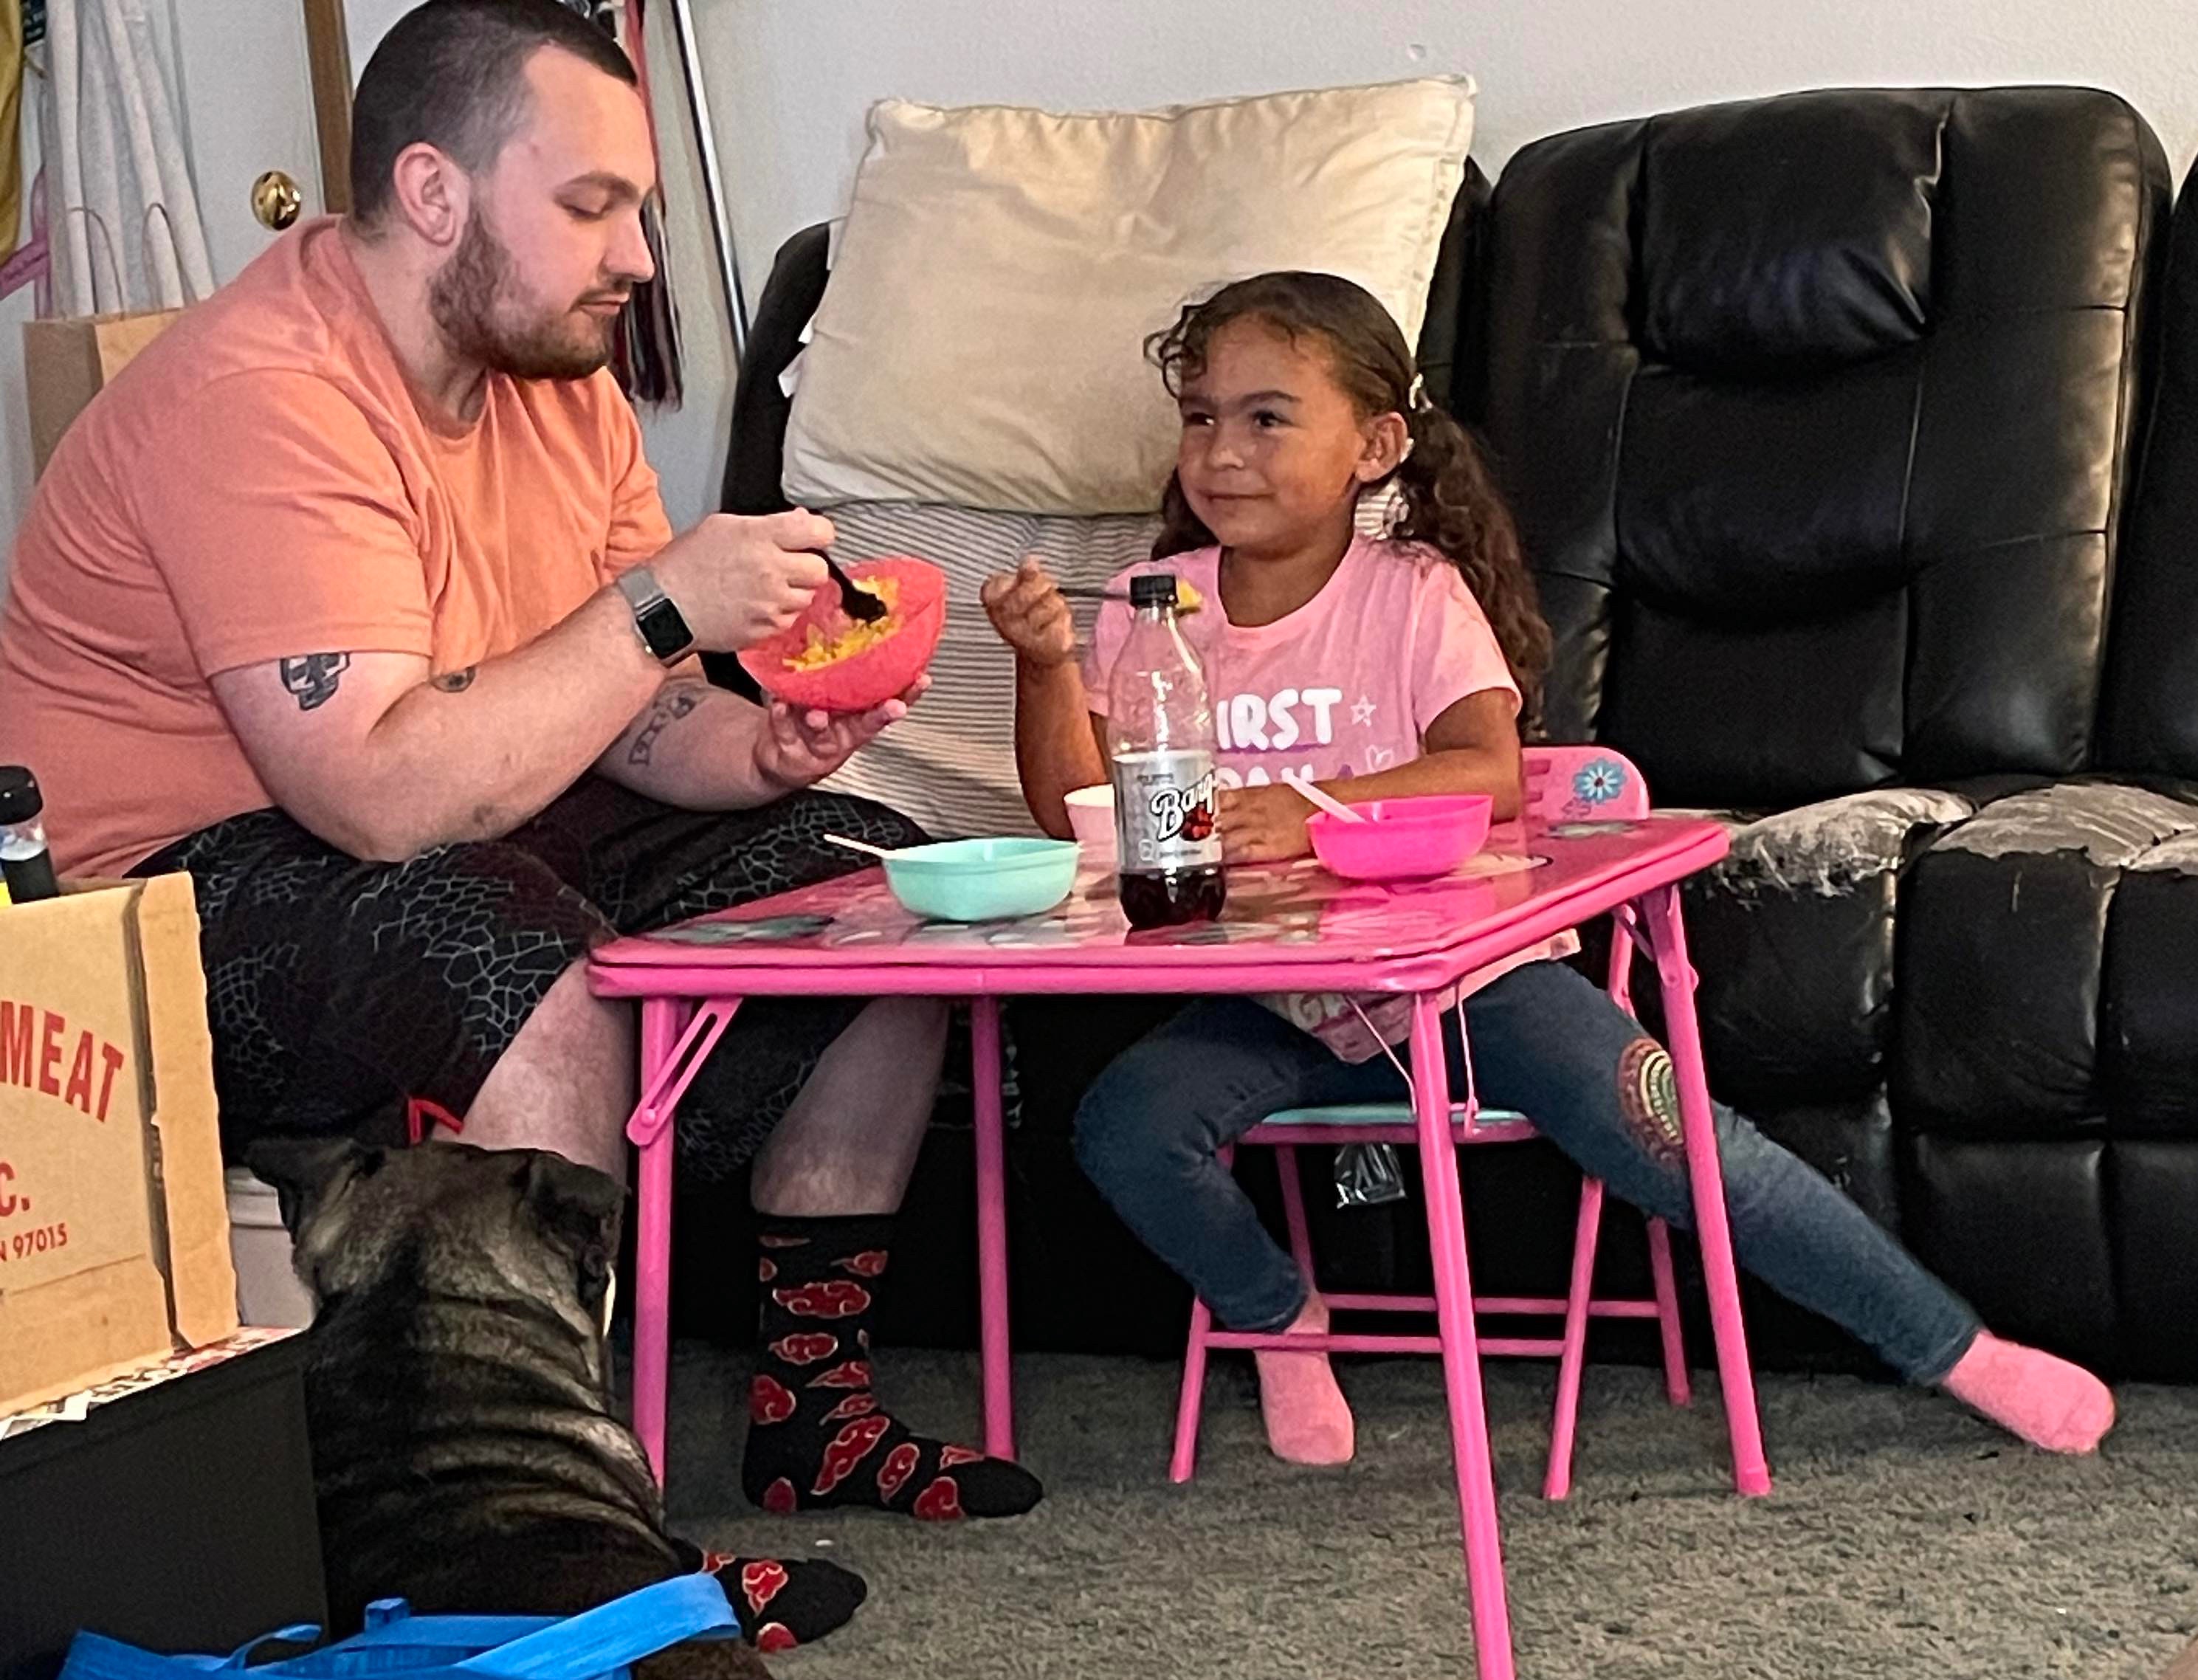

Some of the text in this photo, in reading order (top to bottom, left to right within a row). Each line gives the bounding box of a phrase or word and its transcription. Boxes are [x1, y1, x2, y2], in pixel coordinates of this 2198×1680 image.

[1216, 688, 1343, 751] IRST
[1151, 771, 1216, 841] Barq
[0, 1001, 124, 1123] MEAT
[13, 1222, 67, 1259] 97015
